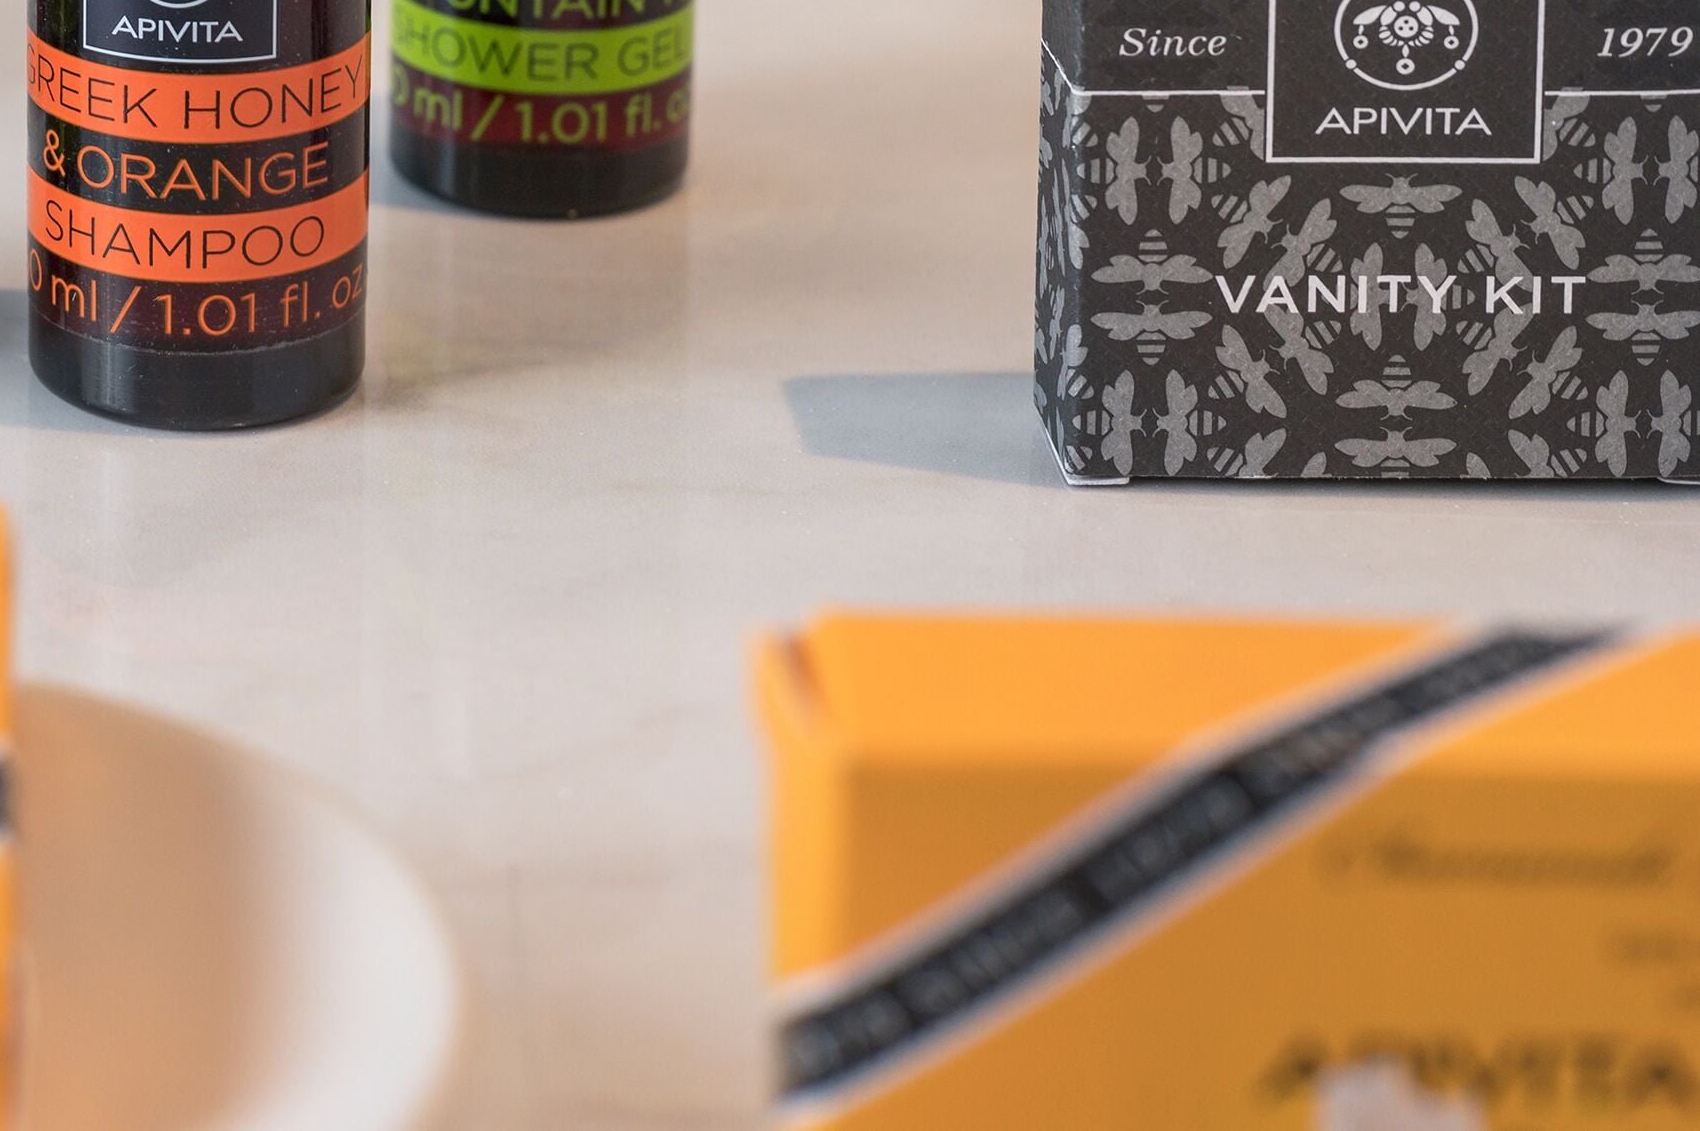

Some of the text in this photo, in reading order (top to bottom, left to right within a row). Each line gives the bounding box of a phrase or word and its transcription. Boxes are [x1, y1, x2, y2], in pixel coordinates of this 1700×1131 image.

[111, 15, 243, 43] APIVITA
[1118, 25, 1694, 59] Since 1979
[26, 43, 363, 130] GREEK HONEY
[412, 86, 463, 131] ml
[515, 102, 608, 145] 1.01
[1315, 106, 1493, 137] APIVITA
[43, 129, 329, 202] & ORANGE
[45, 199, 325, 270] SHAMPOO
[51, 271, 98, 322] ml
[109, 284, 142, 335] /
[157, 291, 257, 338] 1.01
[279, 280, 322, 329] fl.
[1215, 275, 1587, 315] VANITY KIT
